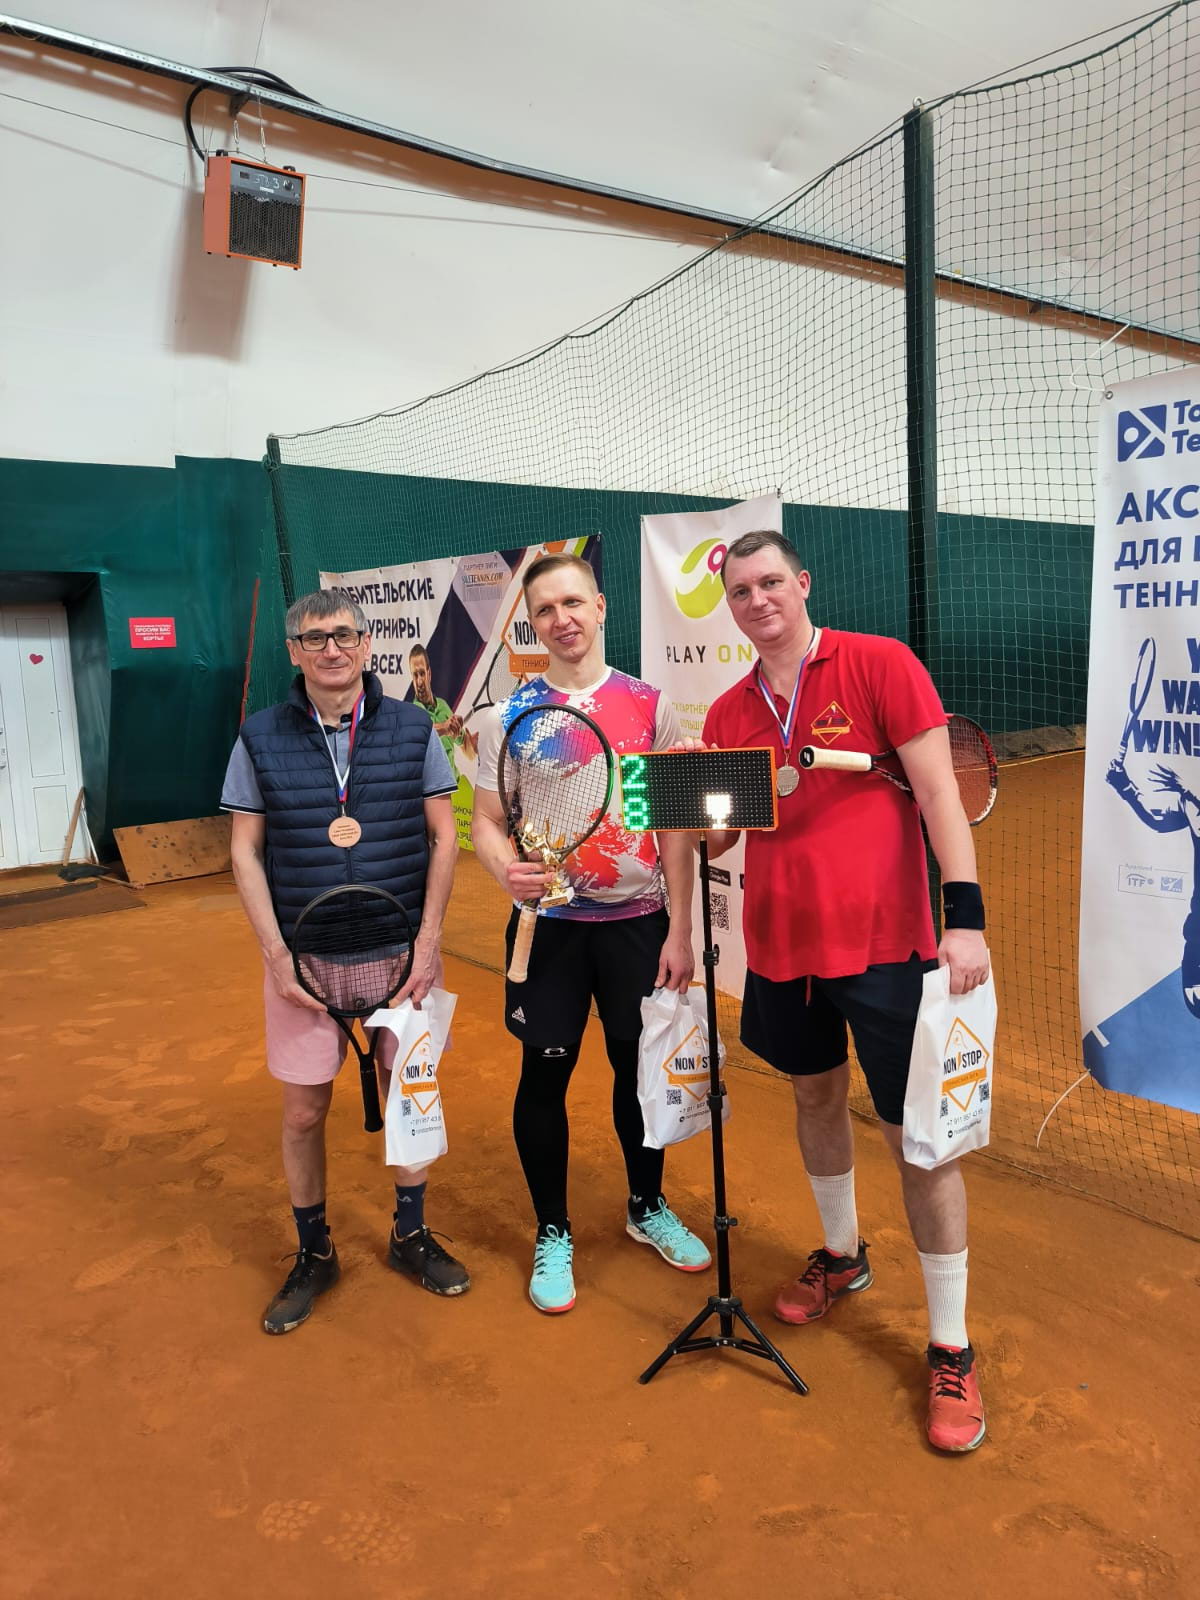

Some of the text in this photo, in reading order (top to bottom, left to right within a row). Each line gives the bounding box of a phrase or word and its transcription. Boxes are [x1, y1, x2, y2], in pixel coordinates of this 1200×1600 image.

[1116, 484, 1200, 526] АКС
[1114, 536, 1182, 572] ДЛЯ
[1113, 580, 1198, 609] ТЕНН
[371, 653, 403, 675] ВСЕХ
[666, 643, 753, 663] PLAY ON
[620, 754, 646, 790] 2
[624, 797, 649, 831] 8
[1127, 877, 1146, 888] ITF
[406, 1065, 420, 1080] NON
[675, 1057, 695, 1071] NON
[944, 1049, 983, 1075] NON STOP
